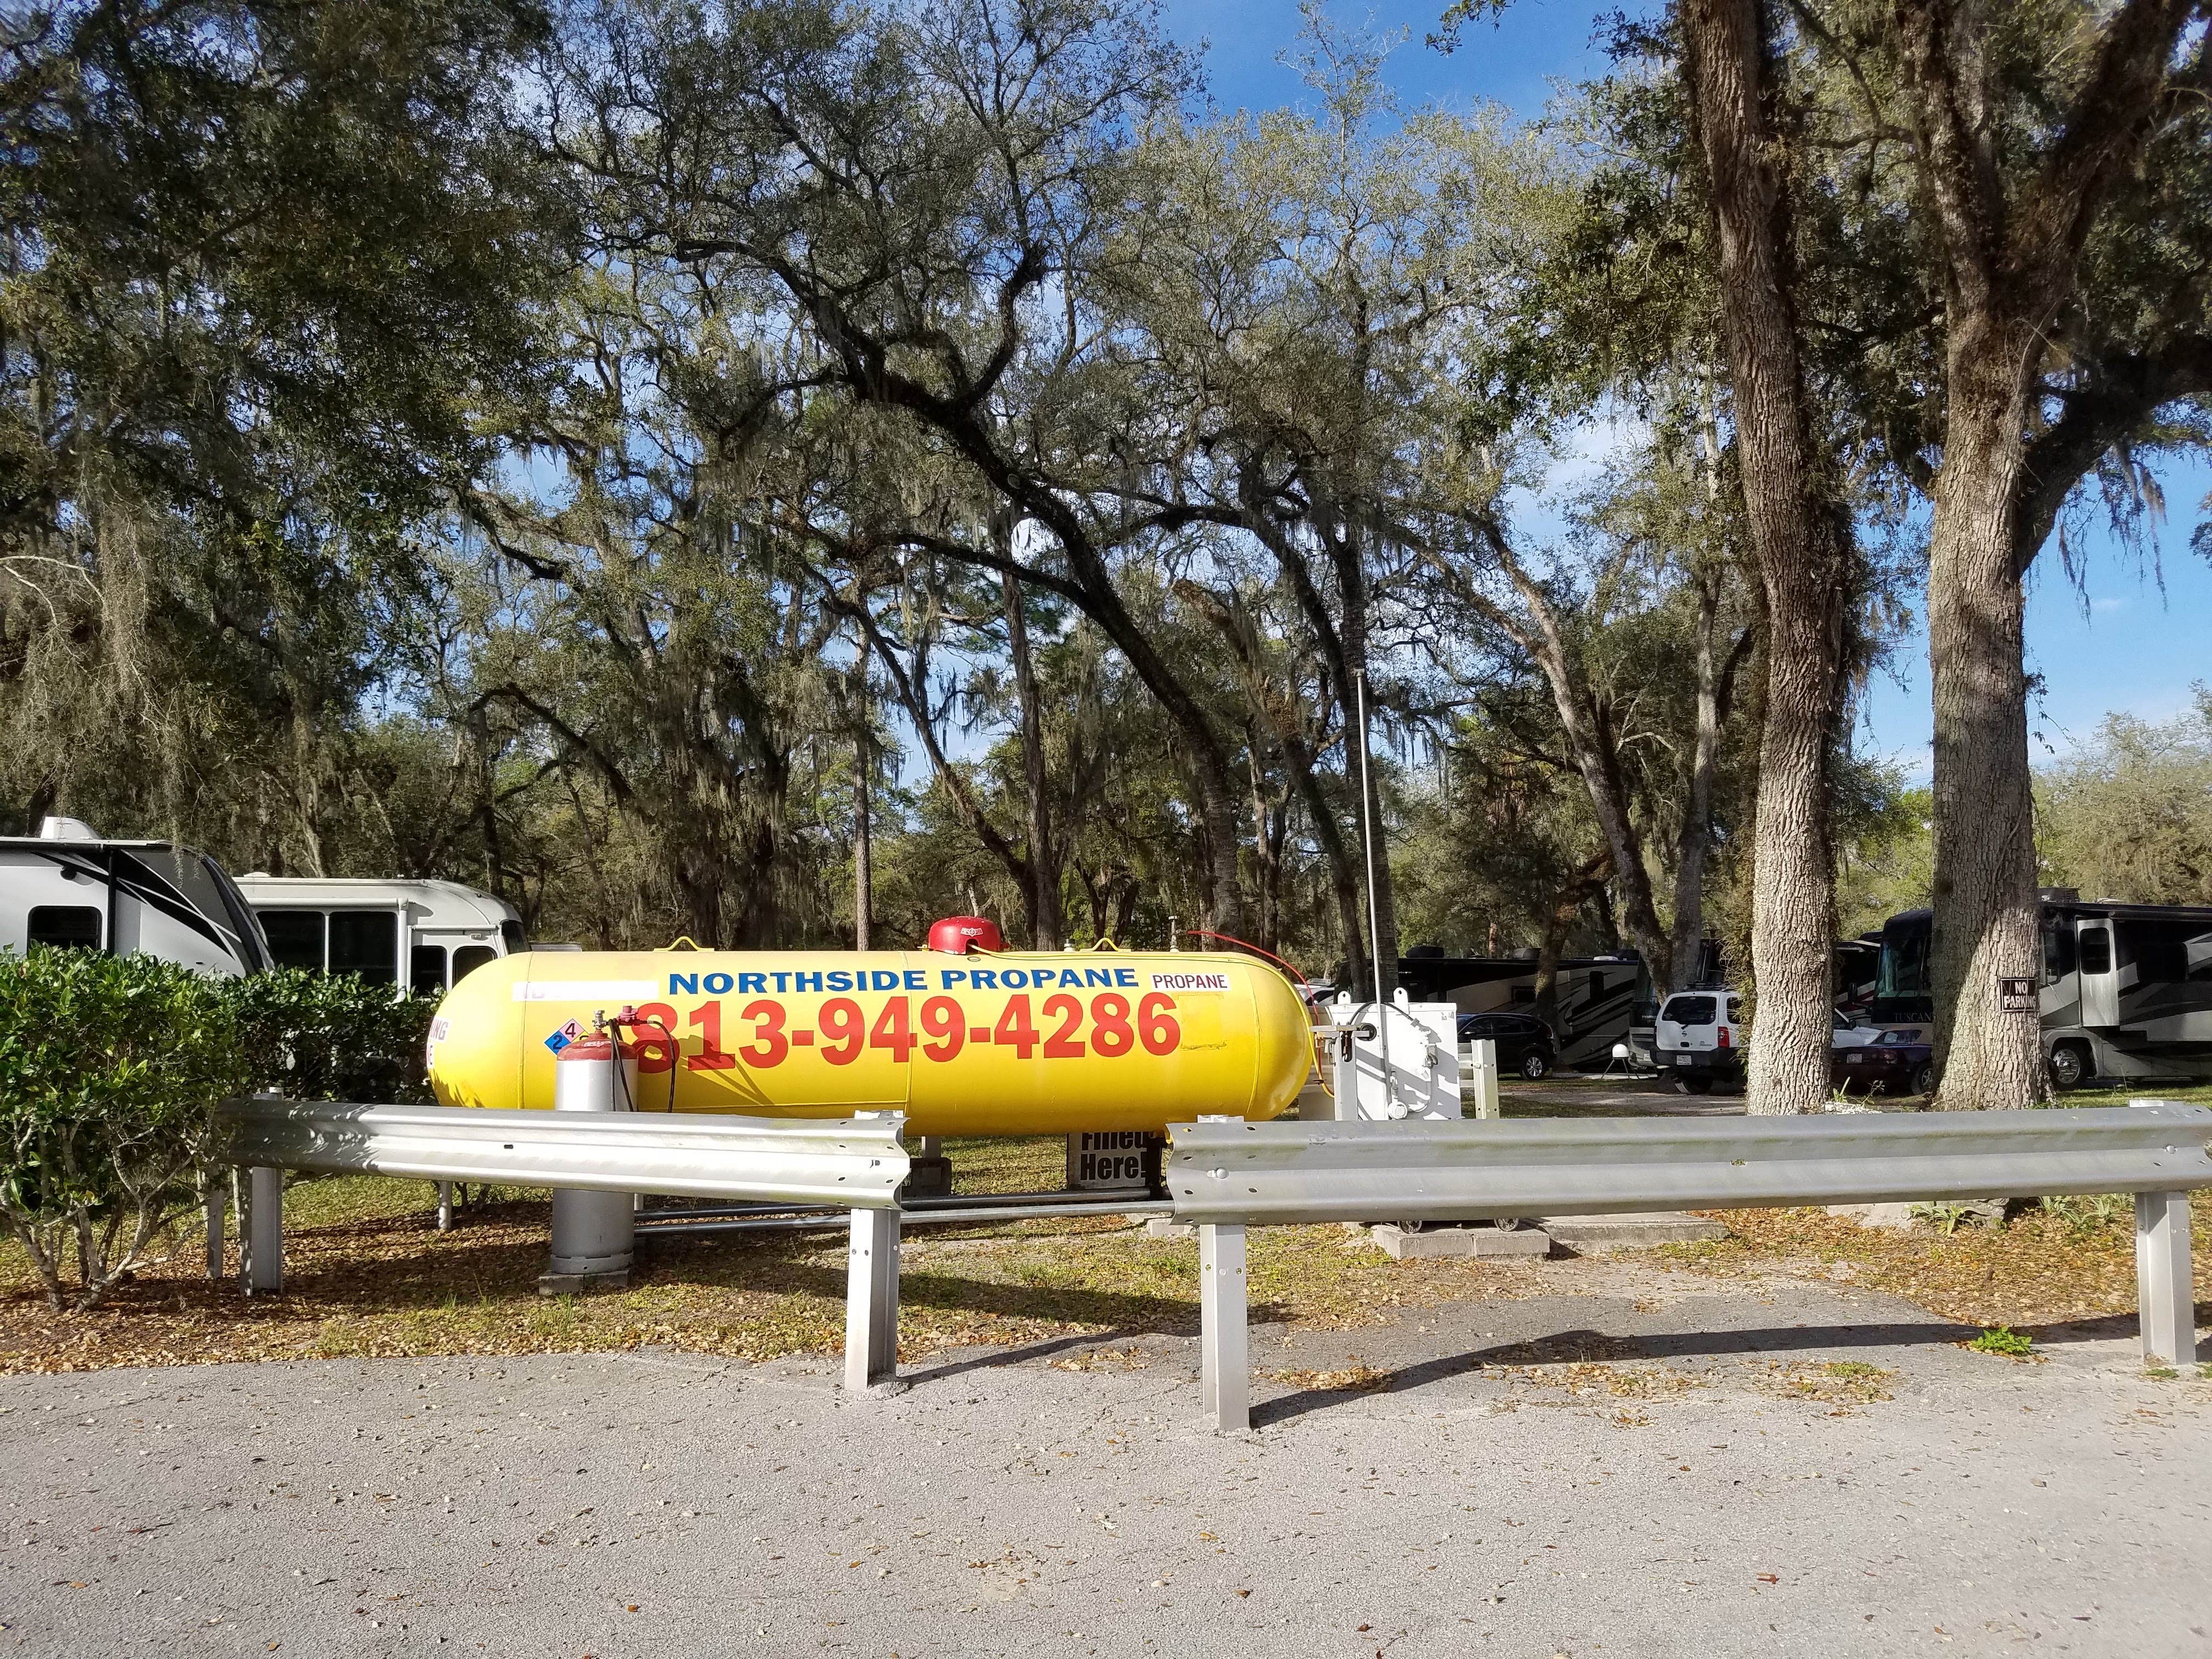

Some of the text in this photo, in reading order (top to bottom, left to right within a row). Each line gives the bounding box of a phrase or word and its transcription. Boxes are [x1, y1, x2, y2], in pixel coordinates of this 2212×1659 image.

[669, 970, 928, 995] NORTHSIDE
[941, 969, 1139, 990] PROPANE
[1152, 975, 1228, 989] PROPANE
[2015, 981, 2028, 994] NO
[2004, 995, 2036, 1008] PARKING
[565, 1023, 576, 1038] 4
[631, 992, 1180, 1074] 813-949-4286
[552, 1035, 563, 1050] 2
[1080, 1152, 1146, 1181] Here!
